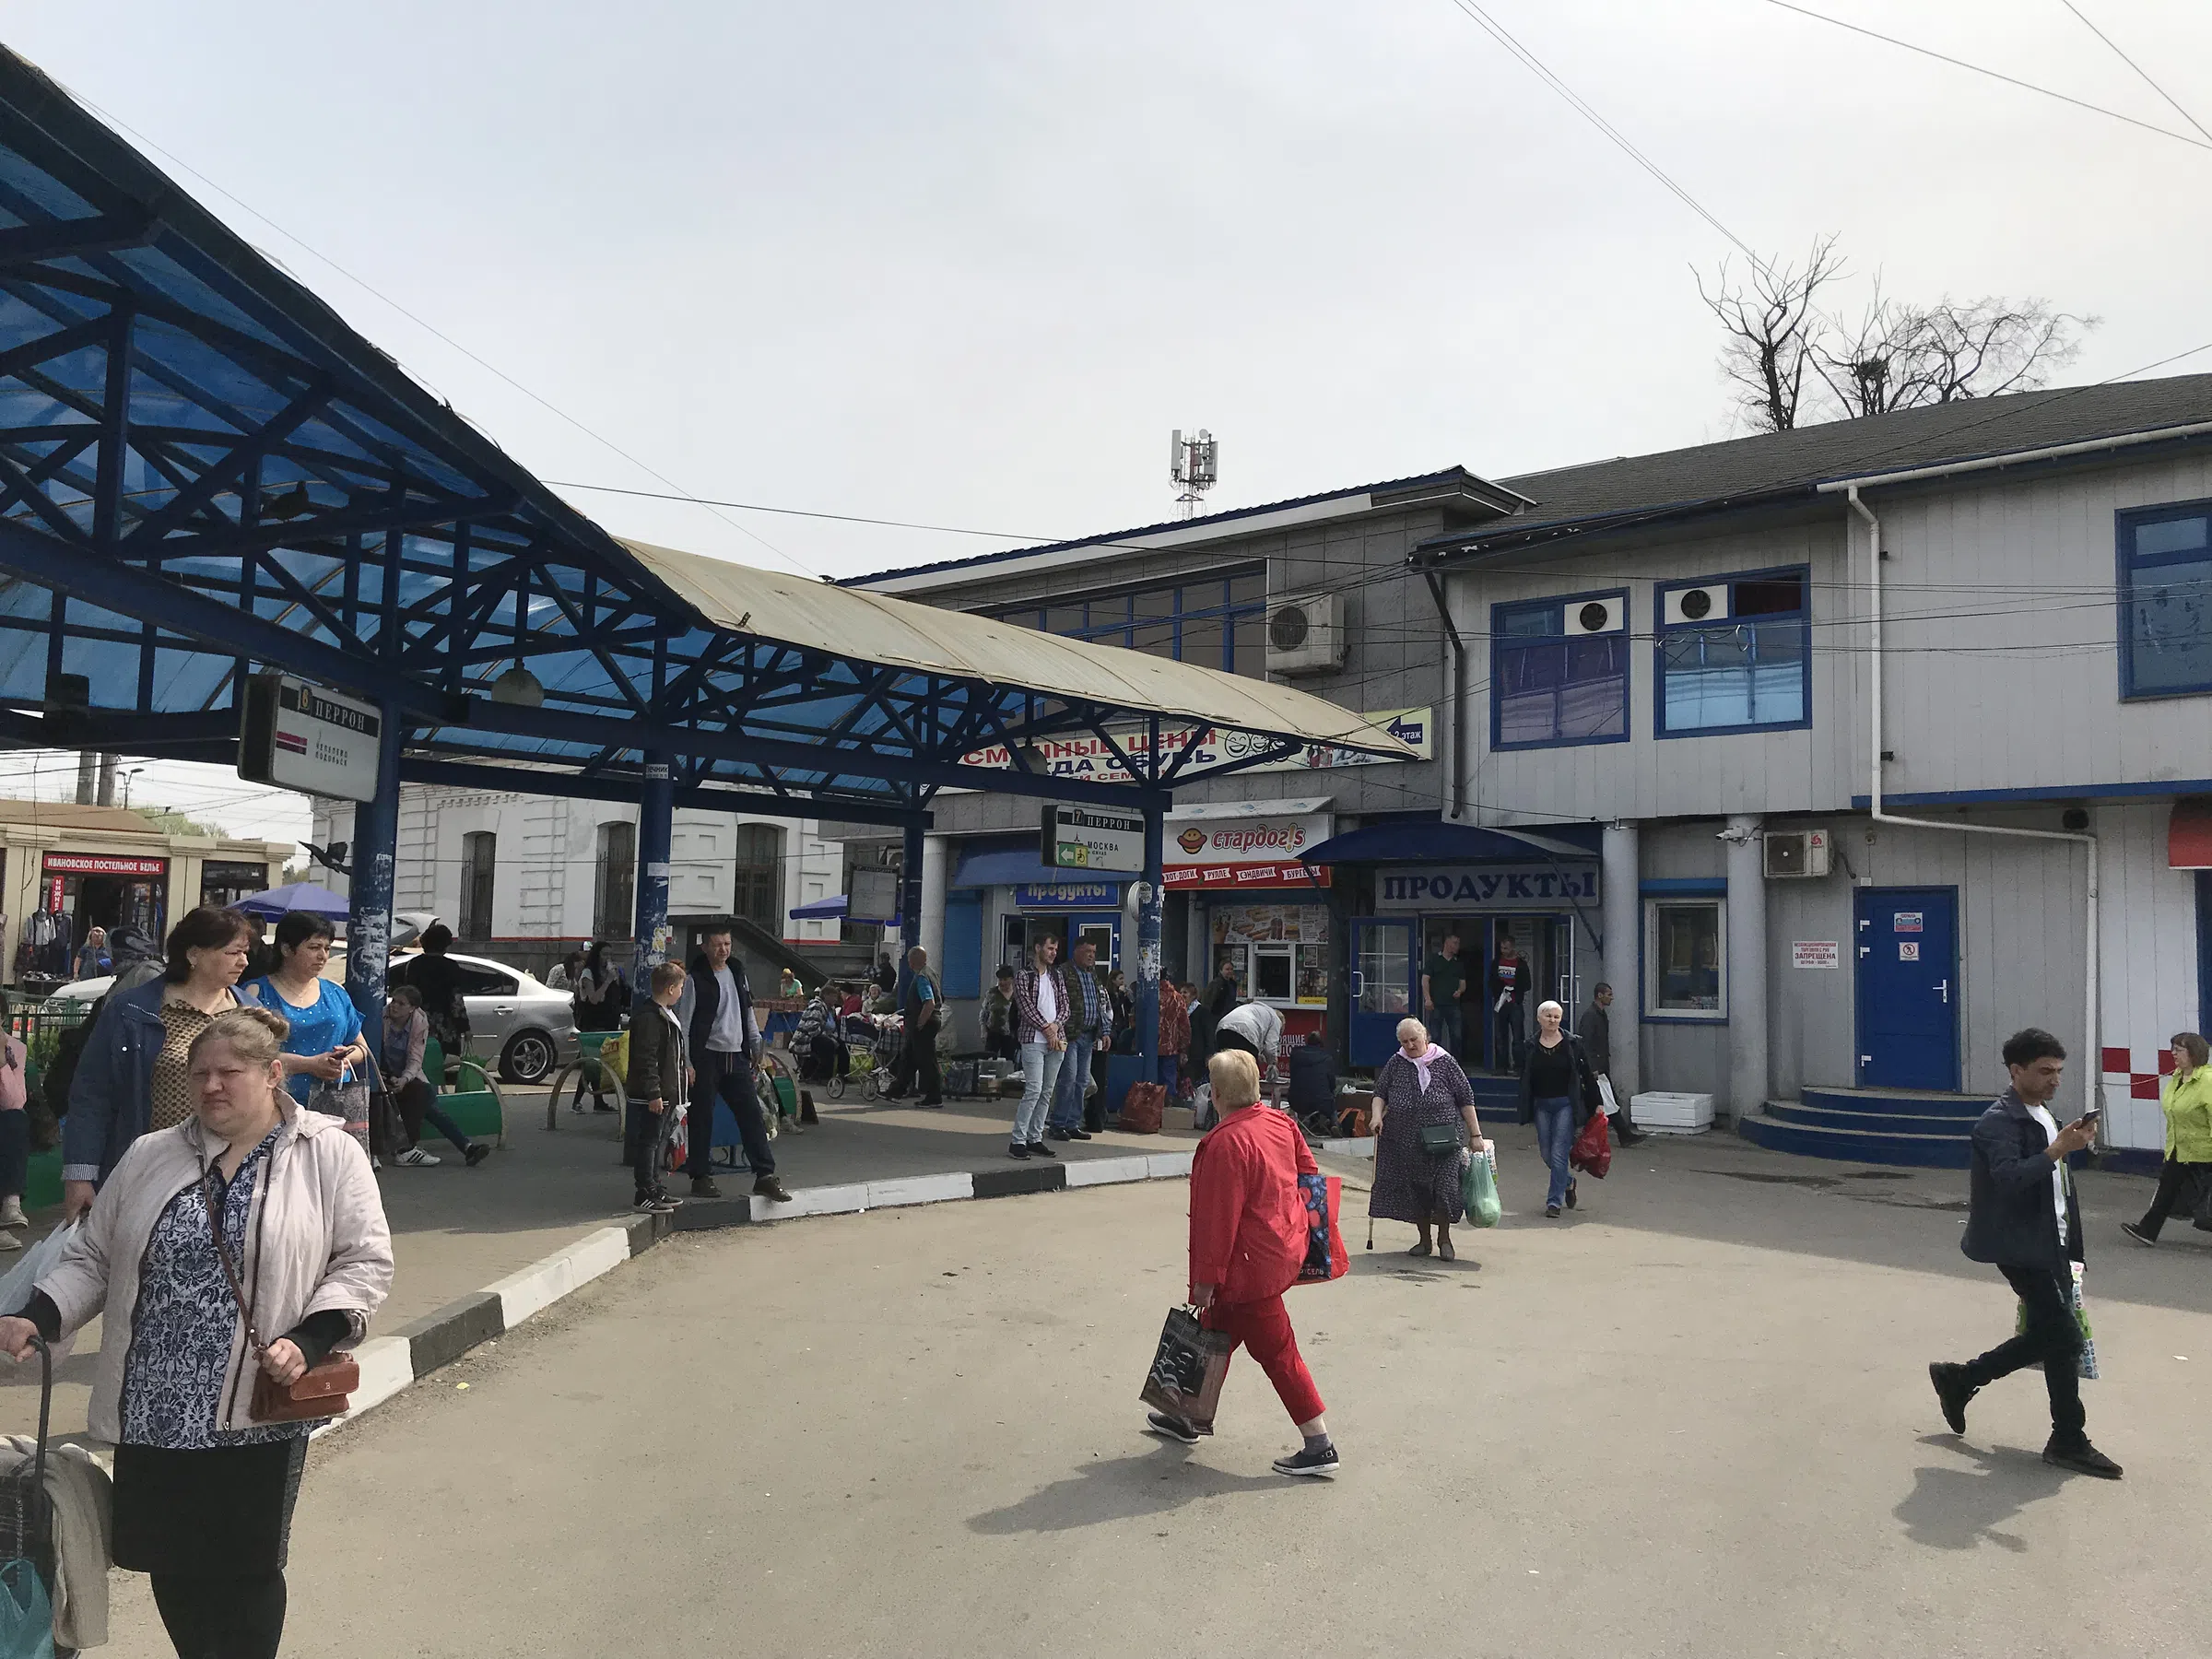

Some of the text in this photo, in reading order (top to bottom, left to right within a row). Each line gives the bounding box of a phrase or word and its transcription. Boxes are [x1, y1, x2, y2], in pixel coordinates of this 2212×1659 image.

[301, 688, 365, 731] 6 ПЕРРОН
[1401, 731, 1421, 740] этаж
[964, 738, 1112, 765] СМНЫЕ
[1076, 811, 1131, 830] 7 ПЕРРОН
[1088, 841, 1119, 852] МОСКВА
[47, 857, 160, 872] ИВАНОВСКОЕ ПОСТЕЛЬНОЕ БЕЛЬЕ
[1165, 869, 1196, 881] ХОТ-ДОГИ
[1206, 869, 1229, 879] РУЛЛЕ
[1240, 866, 1274, 879] СЭНДВИЧИ
[1383, 872, 1596, 902] ПРОДУКТЫ
